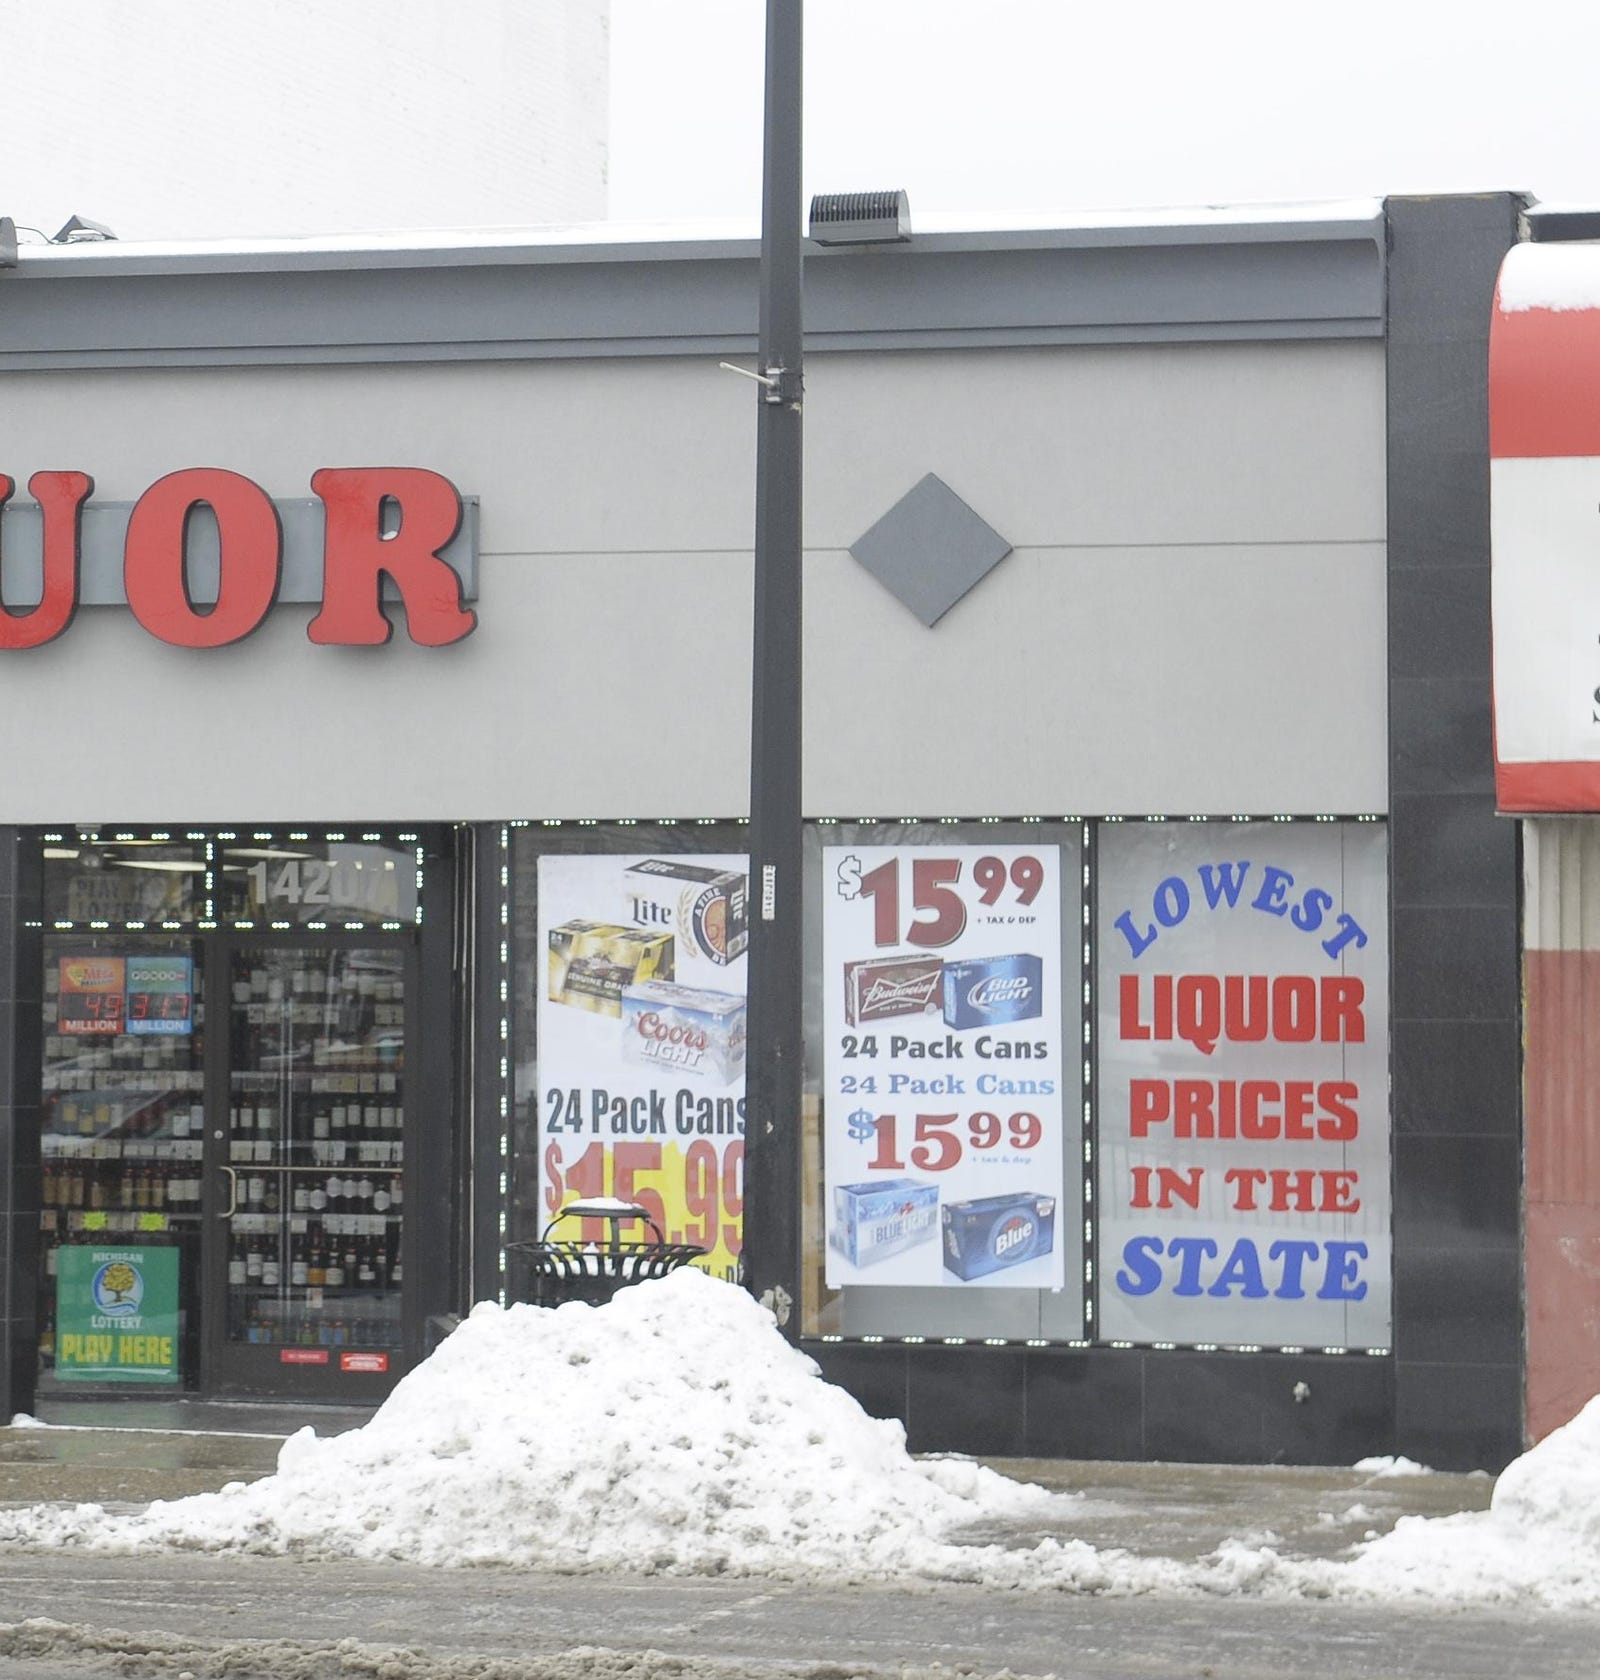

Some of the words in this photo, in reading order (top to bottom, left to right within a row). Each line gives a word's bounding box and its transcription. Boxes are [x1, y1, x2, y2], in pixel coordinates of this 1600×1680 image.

[633, 897, 671, 925] Lite
[986, 916, 1004, 924] TAX
[1019, 916, 1036, 924] DEP
[1113, 861, 1368, 960] LOWEST
[863, 981, 938, 1001] Budweiser
[980, 987, 1032, 1004] LIGHT
[987, 977, 1028, 991] BUD
[86, 994, 122, 1018] 49
[132, 994, 189, 1018] 317
[1119, 974, 1365, 1055] LIQUOR
[66, 1020, 117, 1031] MILLION
[133, 1020, 184, 1030] MILLION
[637, 1012, 709, 1050] Coors
[841, 1035, 878, 1059] 24
[891, 1035, 964, 1059] Pack
[975, 1036, 1048, 1060] Cans
[840, 1075, 877, 1094] 24
[889, 1074, 966, 1094] Pack
[977, 1074, 1054, 1095] Cans
[547, 1088, 583, 1133] 24
[592, 1089, 666, 1134] Pack
[1129, 1079, 1359, 1141] PRICES
[1129, 1166, 1204, 1210] IN
[1224, 1168, 1361, 1214] THE
[995, 1222, 1032, 1256] Blue
[92, 1252, 143, 1263] MICHIGAN
[1115, 1236, 1368, 1302] STATE
[92, 1315, 142, 1328] LOTTERY
[62, 1334, 113, 1363] PLAY
[120, 1335, 172, 1364] HERE
